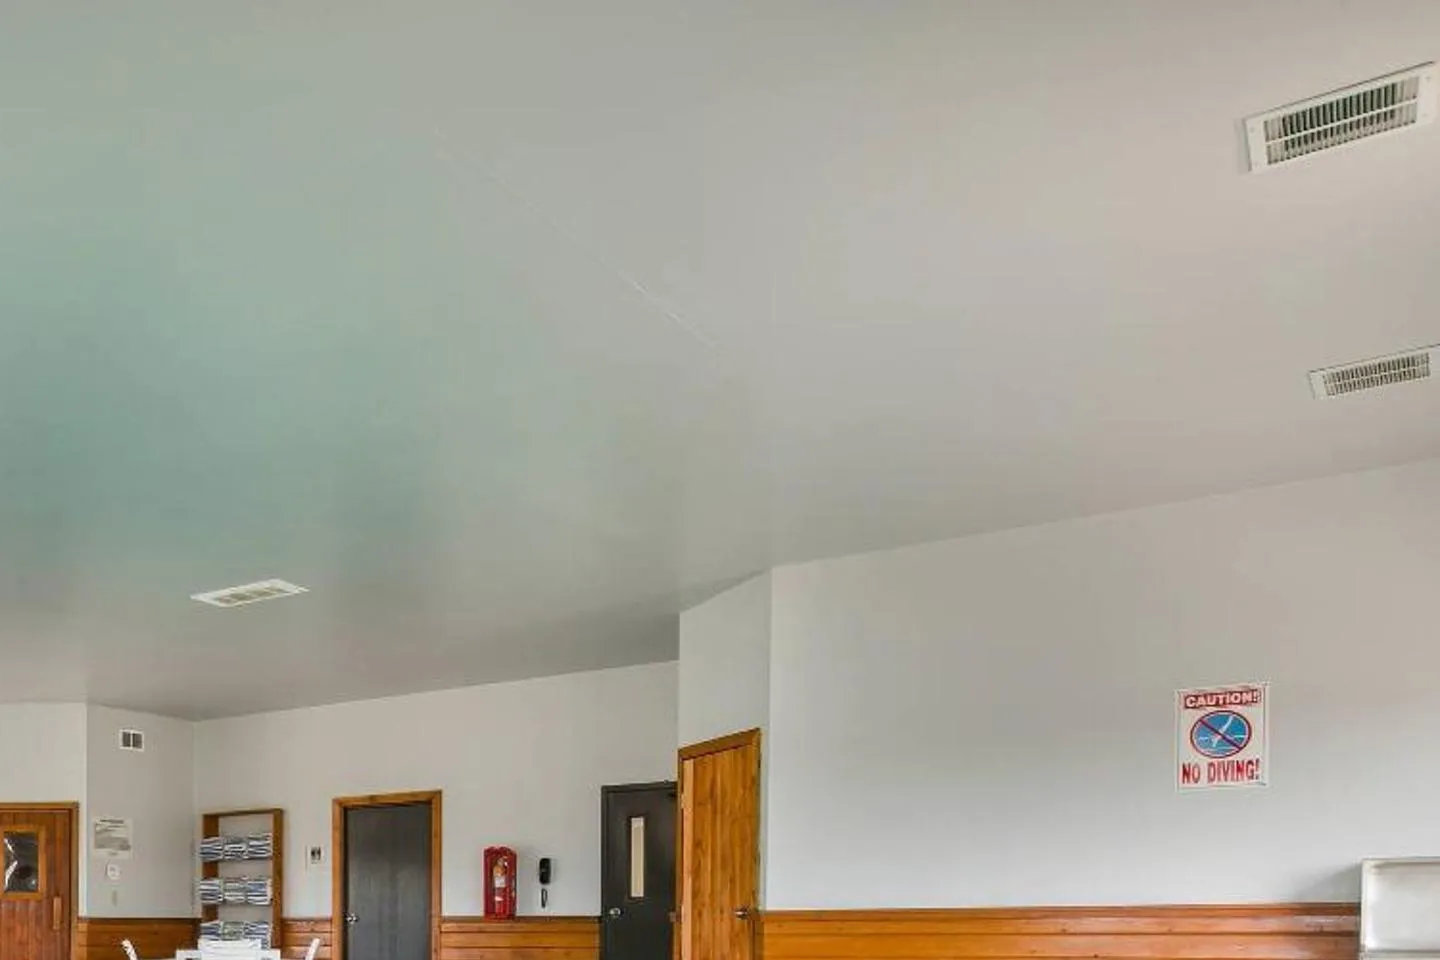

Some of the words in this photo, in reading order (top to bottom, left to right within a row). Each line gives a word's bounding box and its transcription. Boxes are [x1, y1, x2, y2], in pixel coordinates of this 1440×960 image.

[1185, 689, 1259, 709] CAUTION!
[1181, 762, 1201, 784] NO
[1207, 759, 1261, 783] DIVING!
